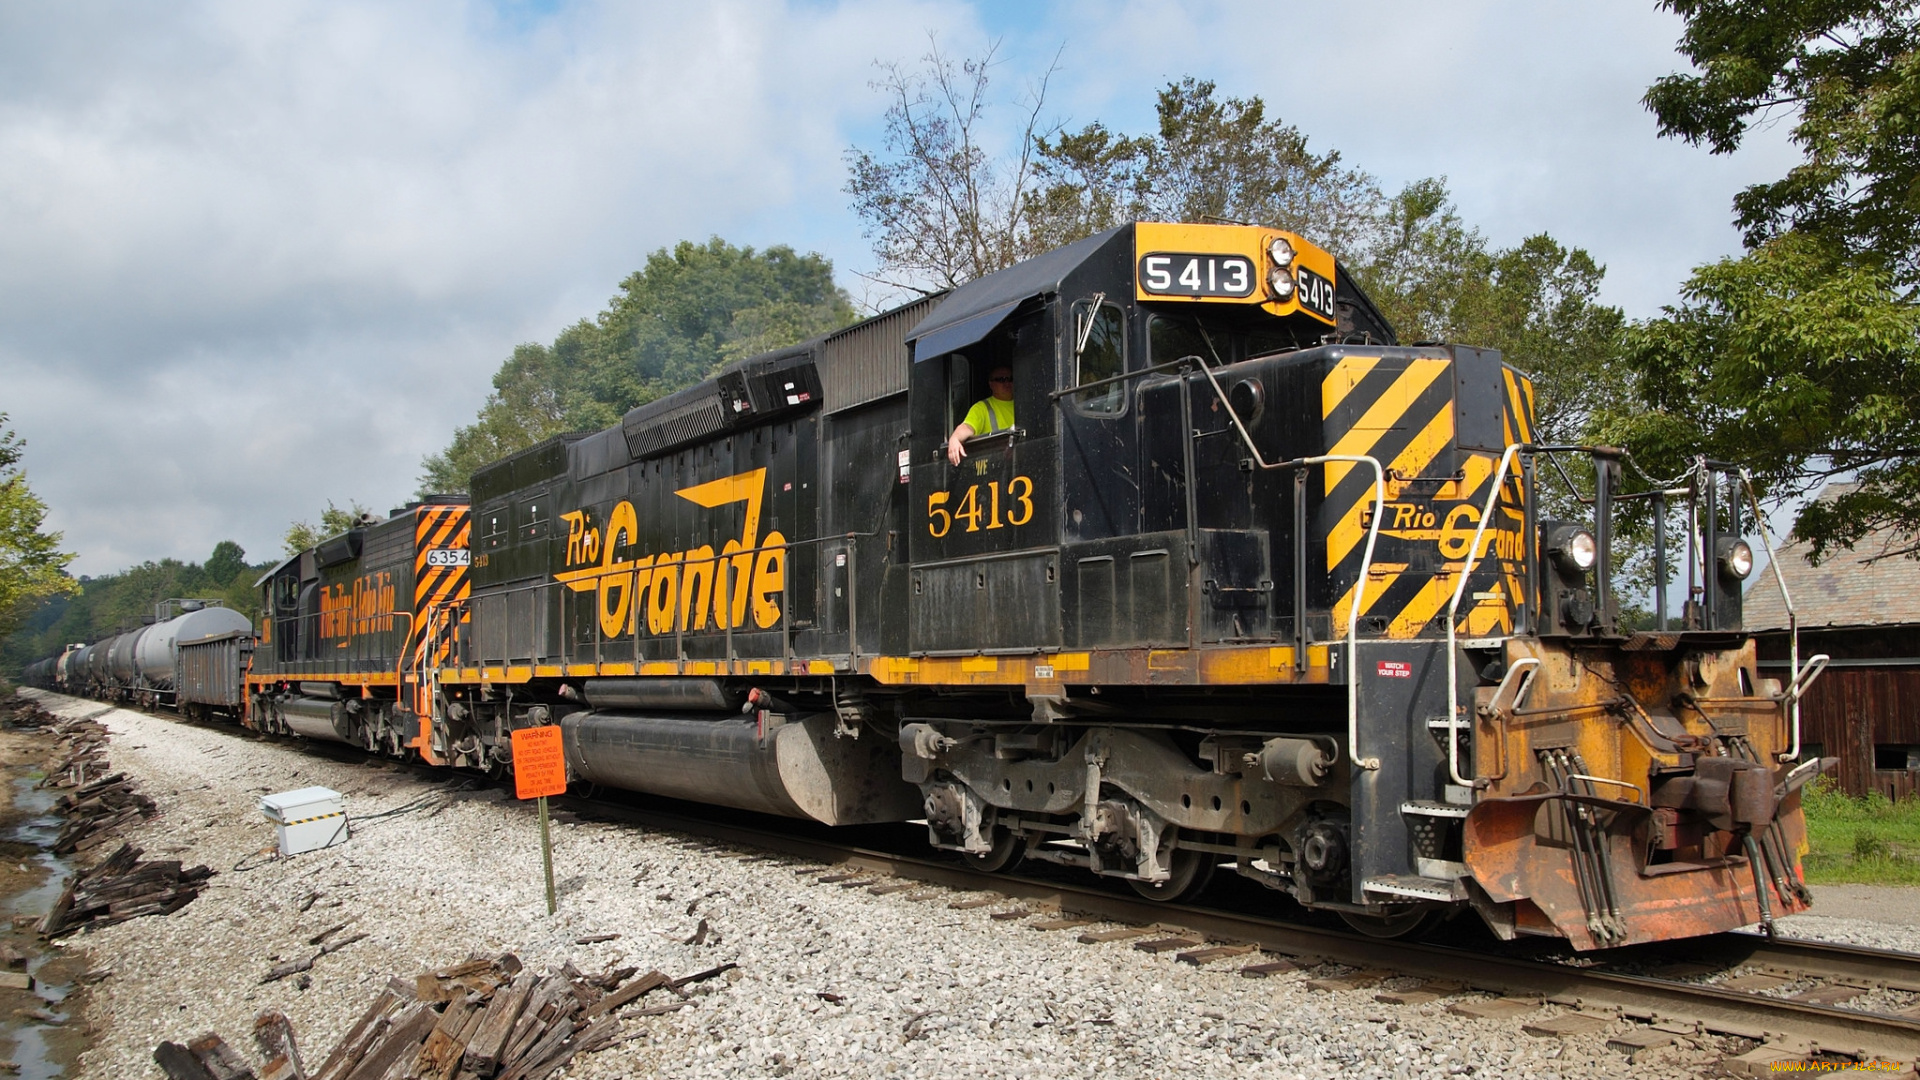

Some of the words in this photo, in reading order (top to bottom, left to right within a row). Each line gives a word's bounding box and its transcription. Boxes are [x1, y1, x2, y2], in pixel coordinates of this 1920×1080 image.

[1146, 257, 1248, 292] 5413
[1298, 269, 1334, 316] 5413
[928, 475, 1034, 538] 5413
[1383, 503, 1436, 529] Rio
[553, 467, 788, 639] Grande
[560, 510, 600, 567] Rio
[1425, 503, 1526, 562] Grand
[429, 551, 470, 564] 6354
[520, 730, 553, 740] WARNING
